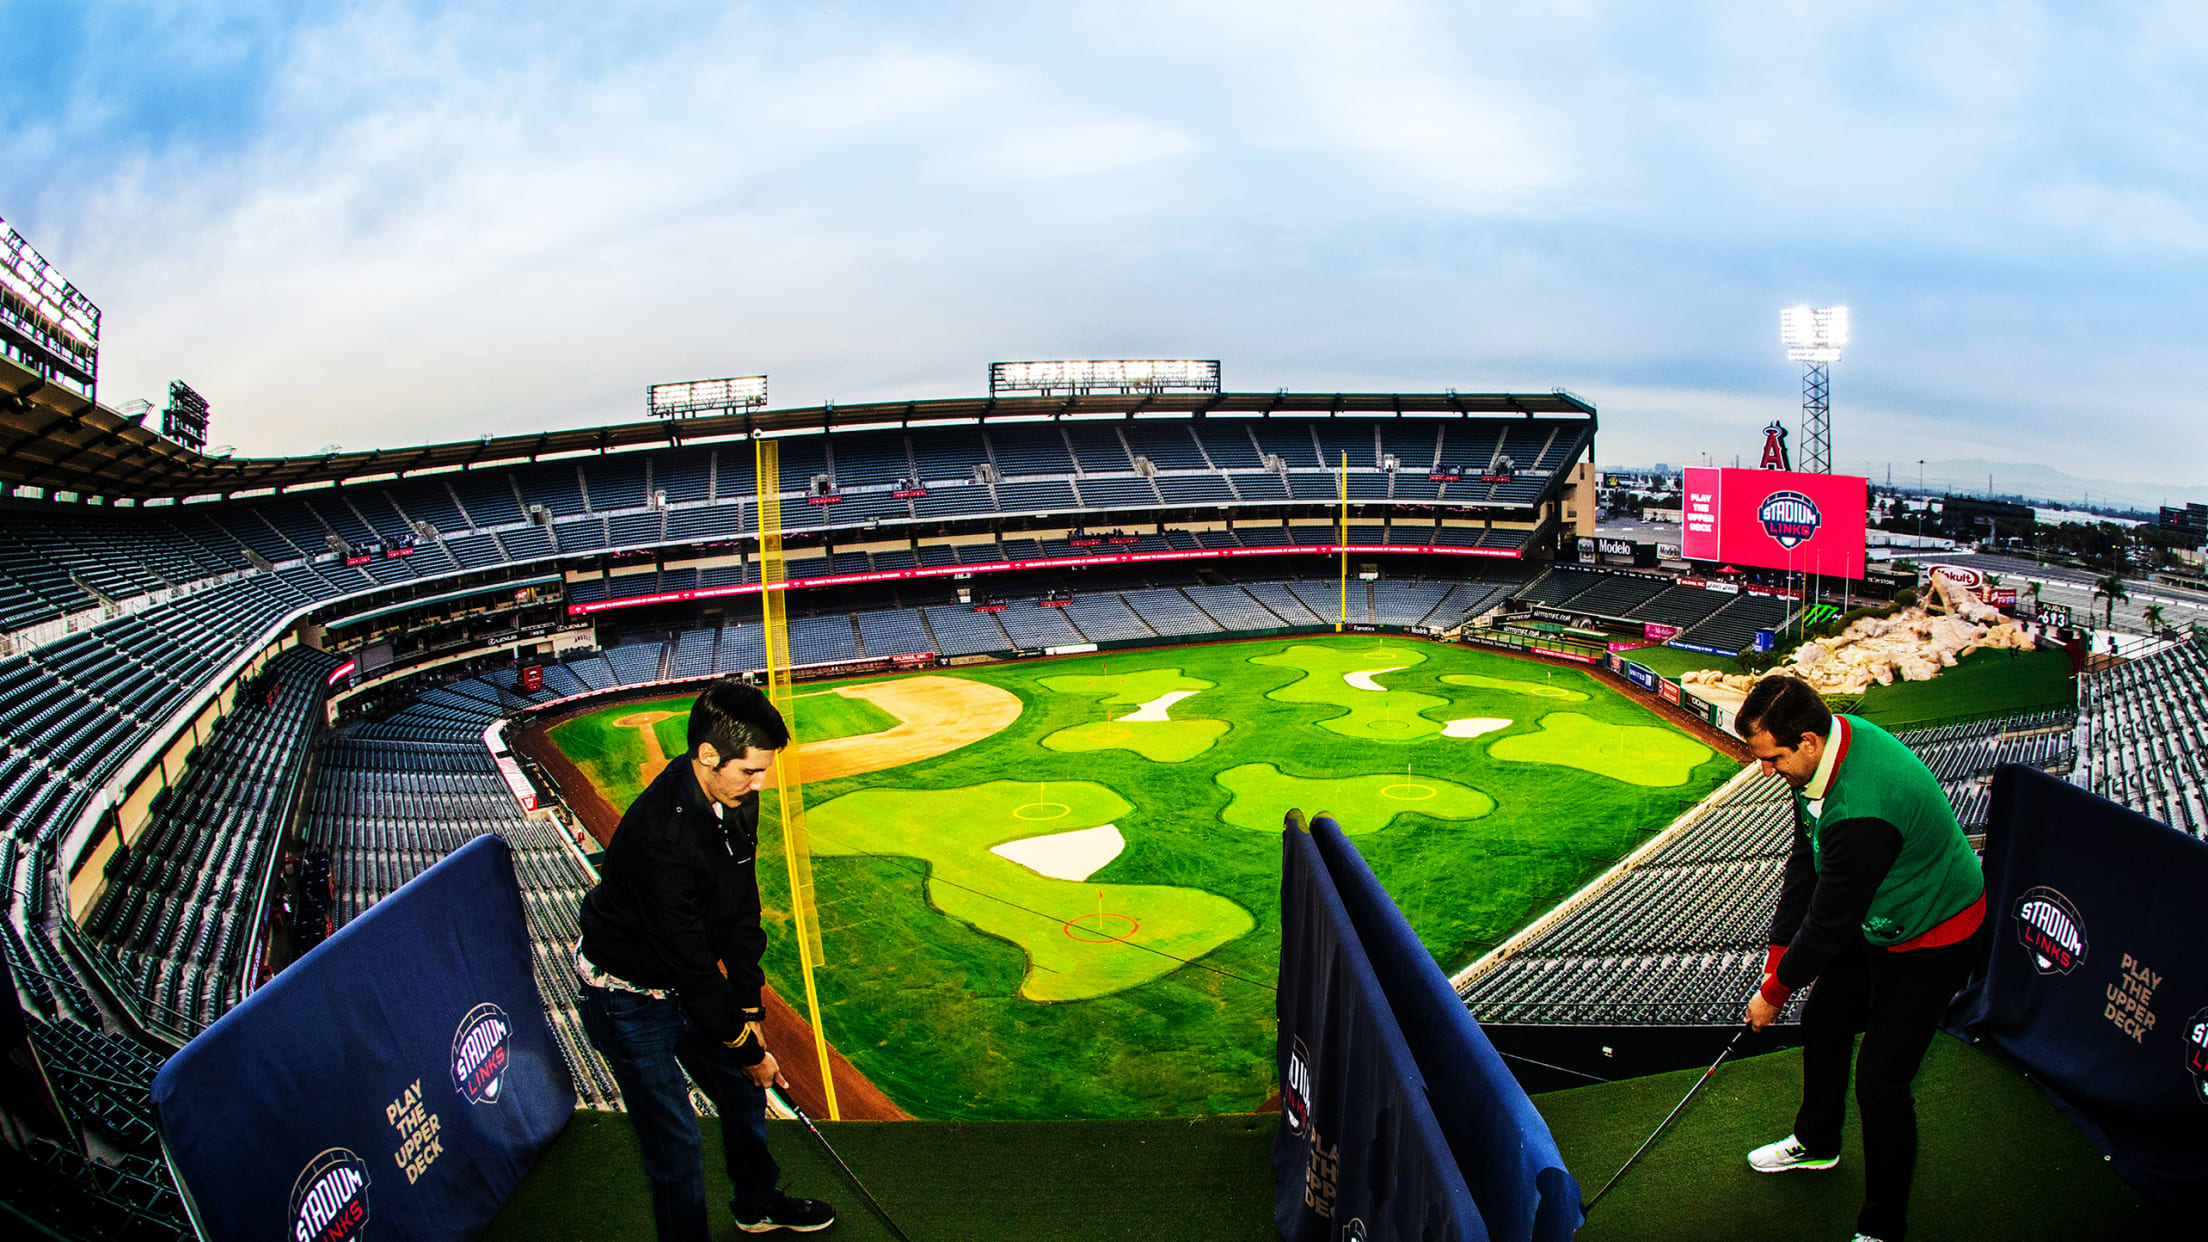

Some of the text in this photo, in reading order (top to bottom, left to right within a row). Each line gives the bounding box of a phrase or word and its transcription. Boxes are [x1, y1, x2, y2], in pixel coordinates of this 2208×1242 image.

[1690, 493, 1712, 503] PLAY
[1692, 503, 1710, 512] THE
[1762, 501, 1817, 525] STADIUM
[1687, 512, 1715, 523] UPPER
[1689, 522, 1712, 533] DECK
[1769, 522, 1811, 536] LINKS
[1599, 539, 1631, 555] Modelo
[2020, 901, 2082, 956] STADIUM
[2024, 925, 2071, 968] LINKS
[2120, 953, 2163, 991] PLAY
[2121, 972, 2152, 1006] THE
[2104, 1002, 2147, 1045] DECK
[2106, 982, 2157, 1030] UPPER
[456, 1018, 507, 1082] STADIUM
[467, 1045, 505, 1096] LINKS
[385, 1078, 423, 1126] PLAY
[396, 1101, 427, 1140] THE
[394, 1113, 442, 1169] UPPER
[405, 1135, 444, 1185] DECK
[1311, 1149, 1337, 1181] TH
[295, 1167, 363, 1242] STADIUM
[1305, 1186, 1335, 1218] DE
